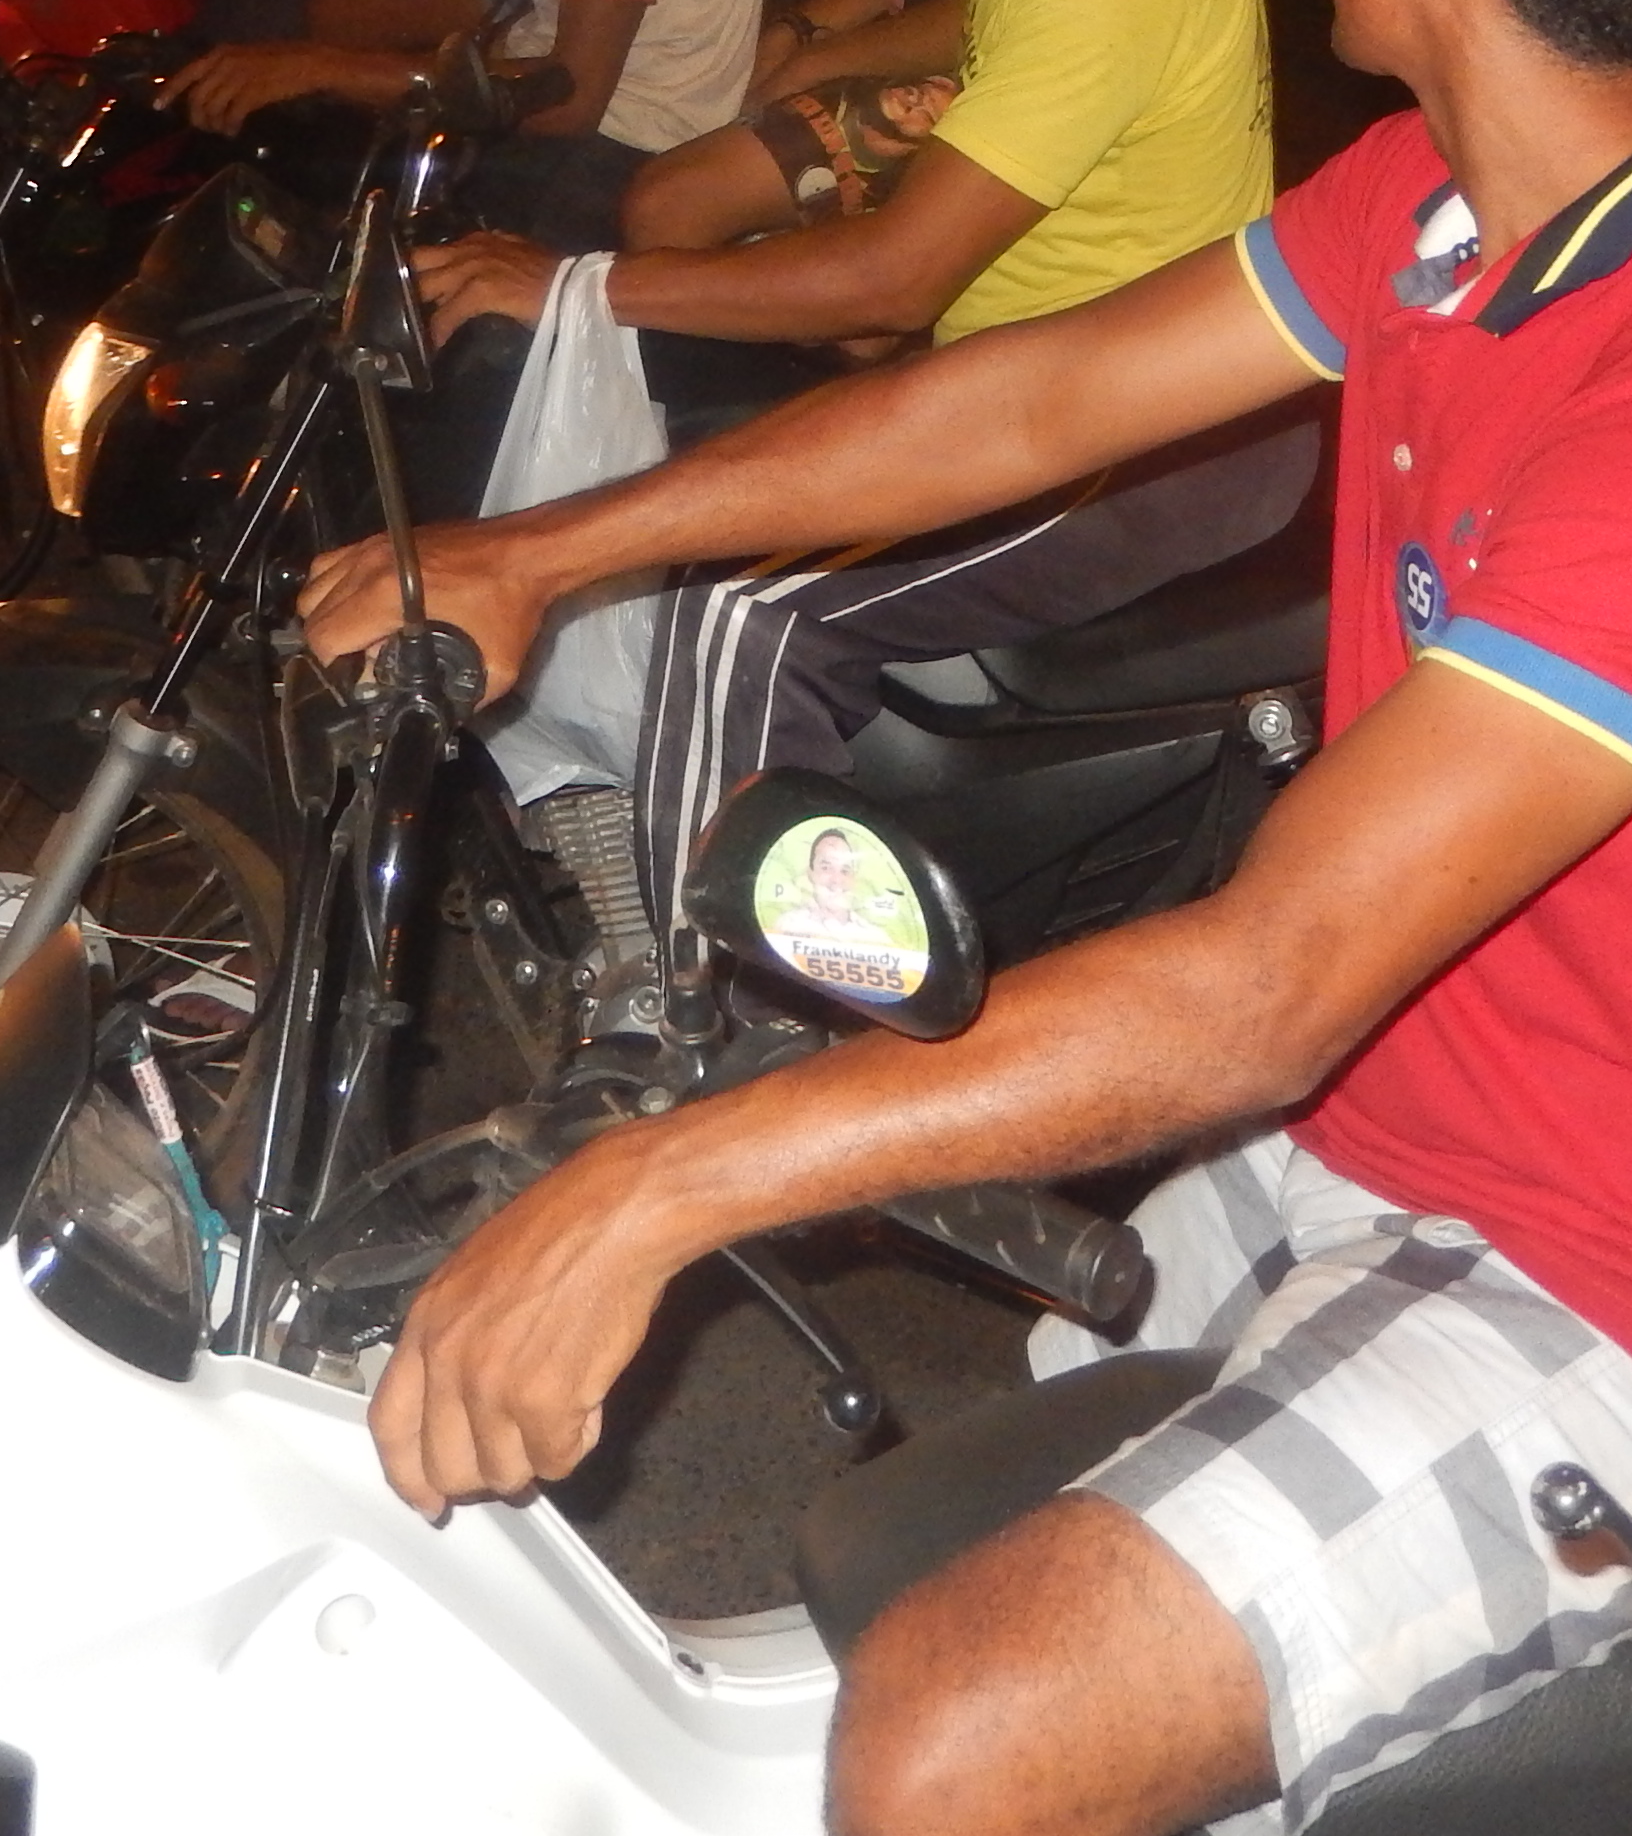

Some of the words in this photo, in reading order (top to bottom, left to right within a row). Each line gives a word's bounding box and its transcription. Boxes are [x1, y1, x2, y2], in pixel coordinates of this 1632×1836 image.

[1406, 563, 1433, 619] 55
[792, 940, 901, 969] Frankilandy
[806, 957, 905, 991] 55555
